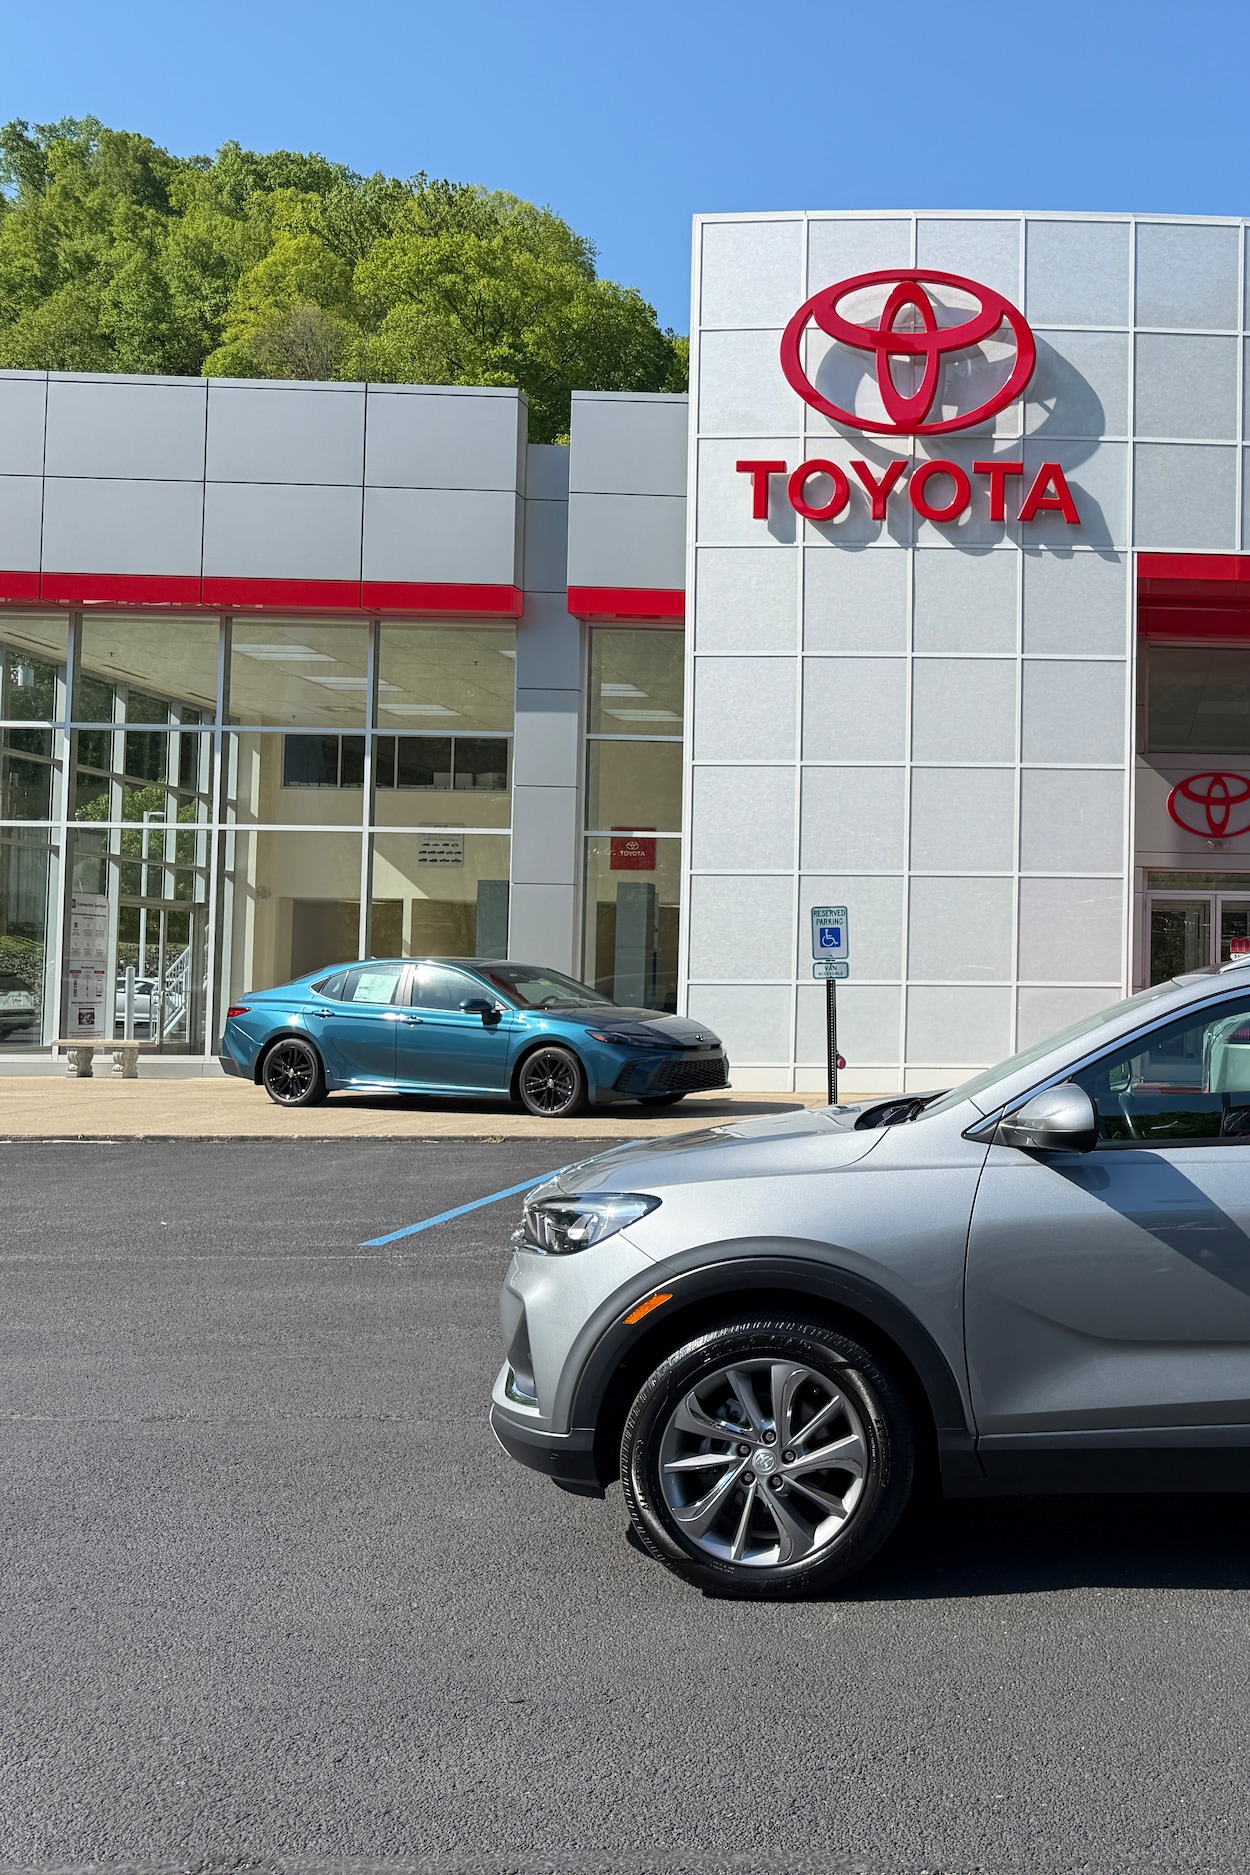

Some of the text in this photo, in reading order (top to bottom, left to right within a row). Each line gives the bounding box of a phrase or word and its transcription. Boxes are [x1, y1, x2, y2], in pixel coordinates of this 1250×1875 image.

[736, 459, 1081, 525] TOYOTA
[813, 909, 846, 918] RESERVED
[816, 918, 844, 926] PARKING
